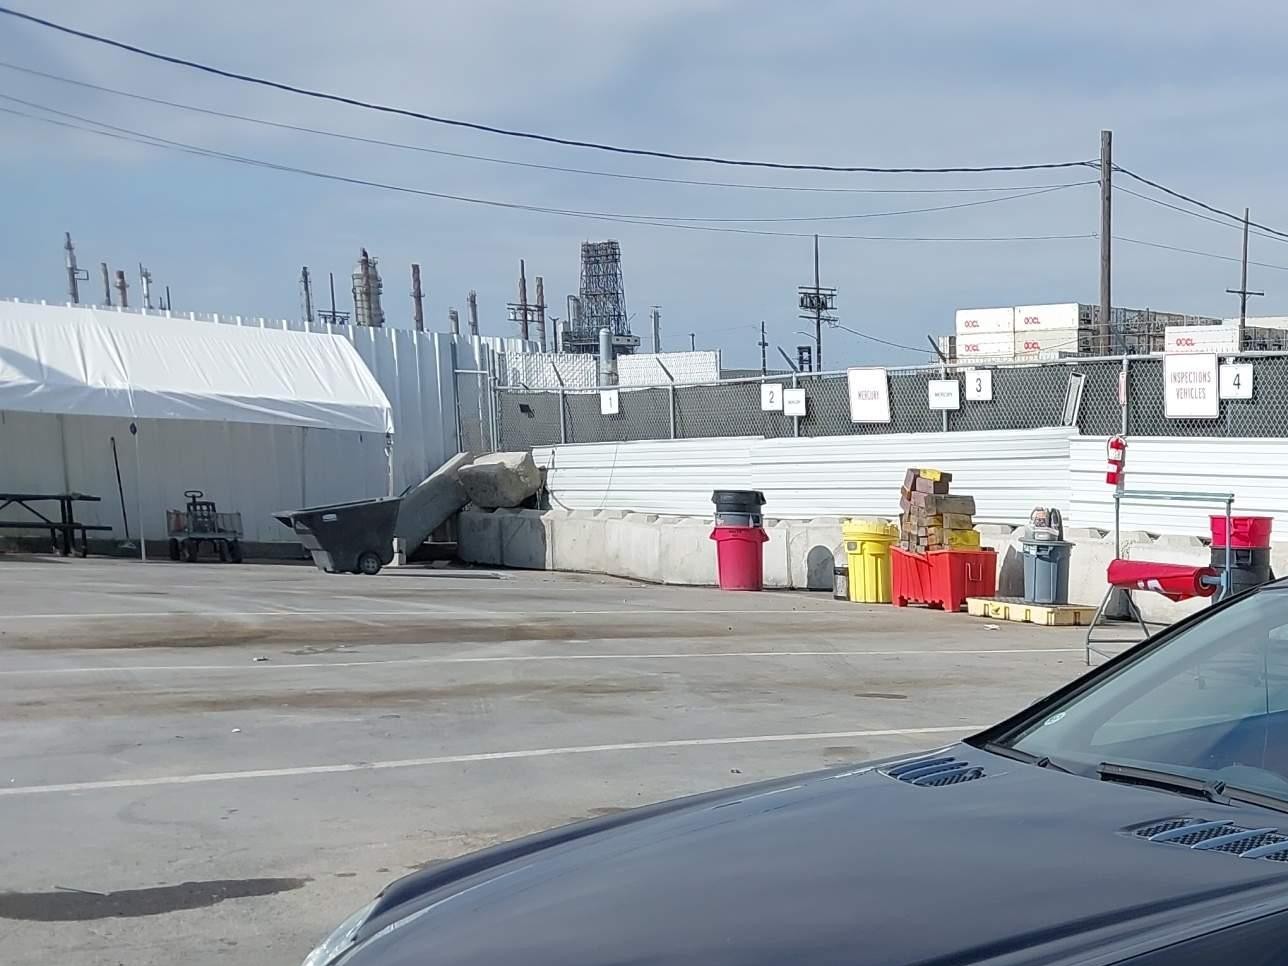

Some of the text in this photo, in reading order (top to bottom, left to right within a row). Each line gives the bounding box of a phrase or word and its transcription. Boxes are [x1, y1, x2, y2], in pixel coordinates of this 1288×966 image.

[1170, 372, 1211, 384] INSPECTIONS
[1233, 373, 1241, 390] 4
[975, 378, 982, 393] 3
[768, 390, 774, 403] 2
[858, 390, 879, 401] MERCURY
[1176, 387, 1206, 400] VEHICLES
